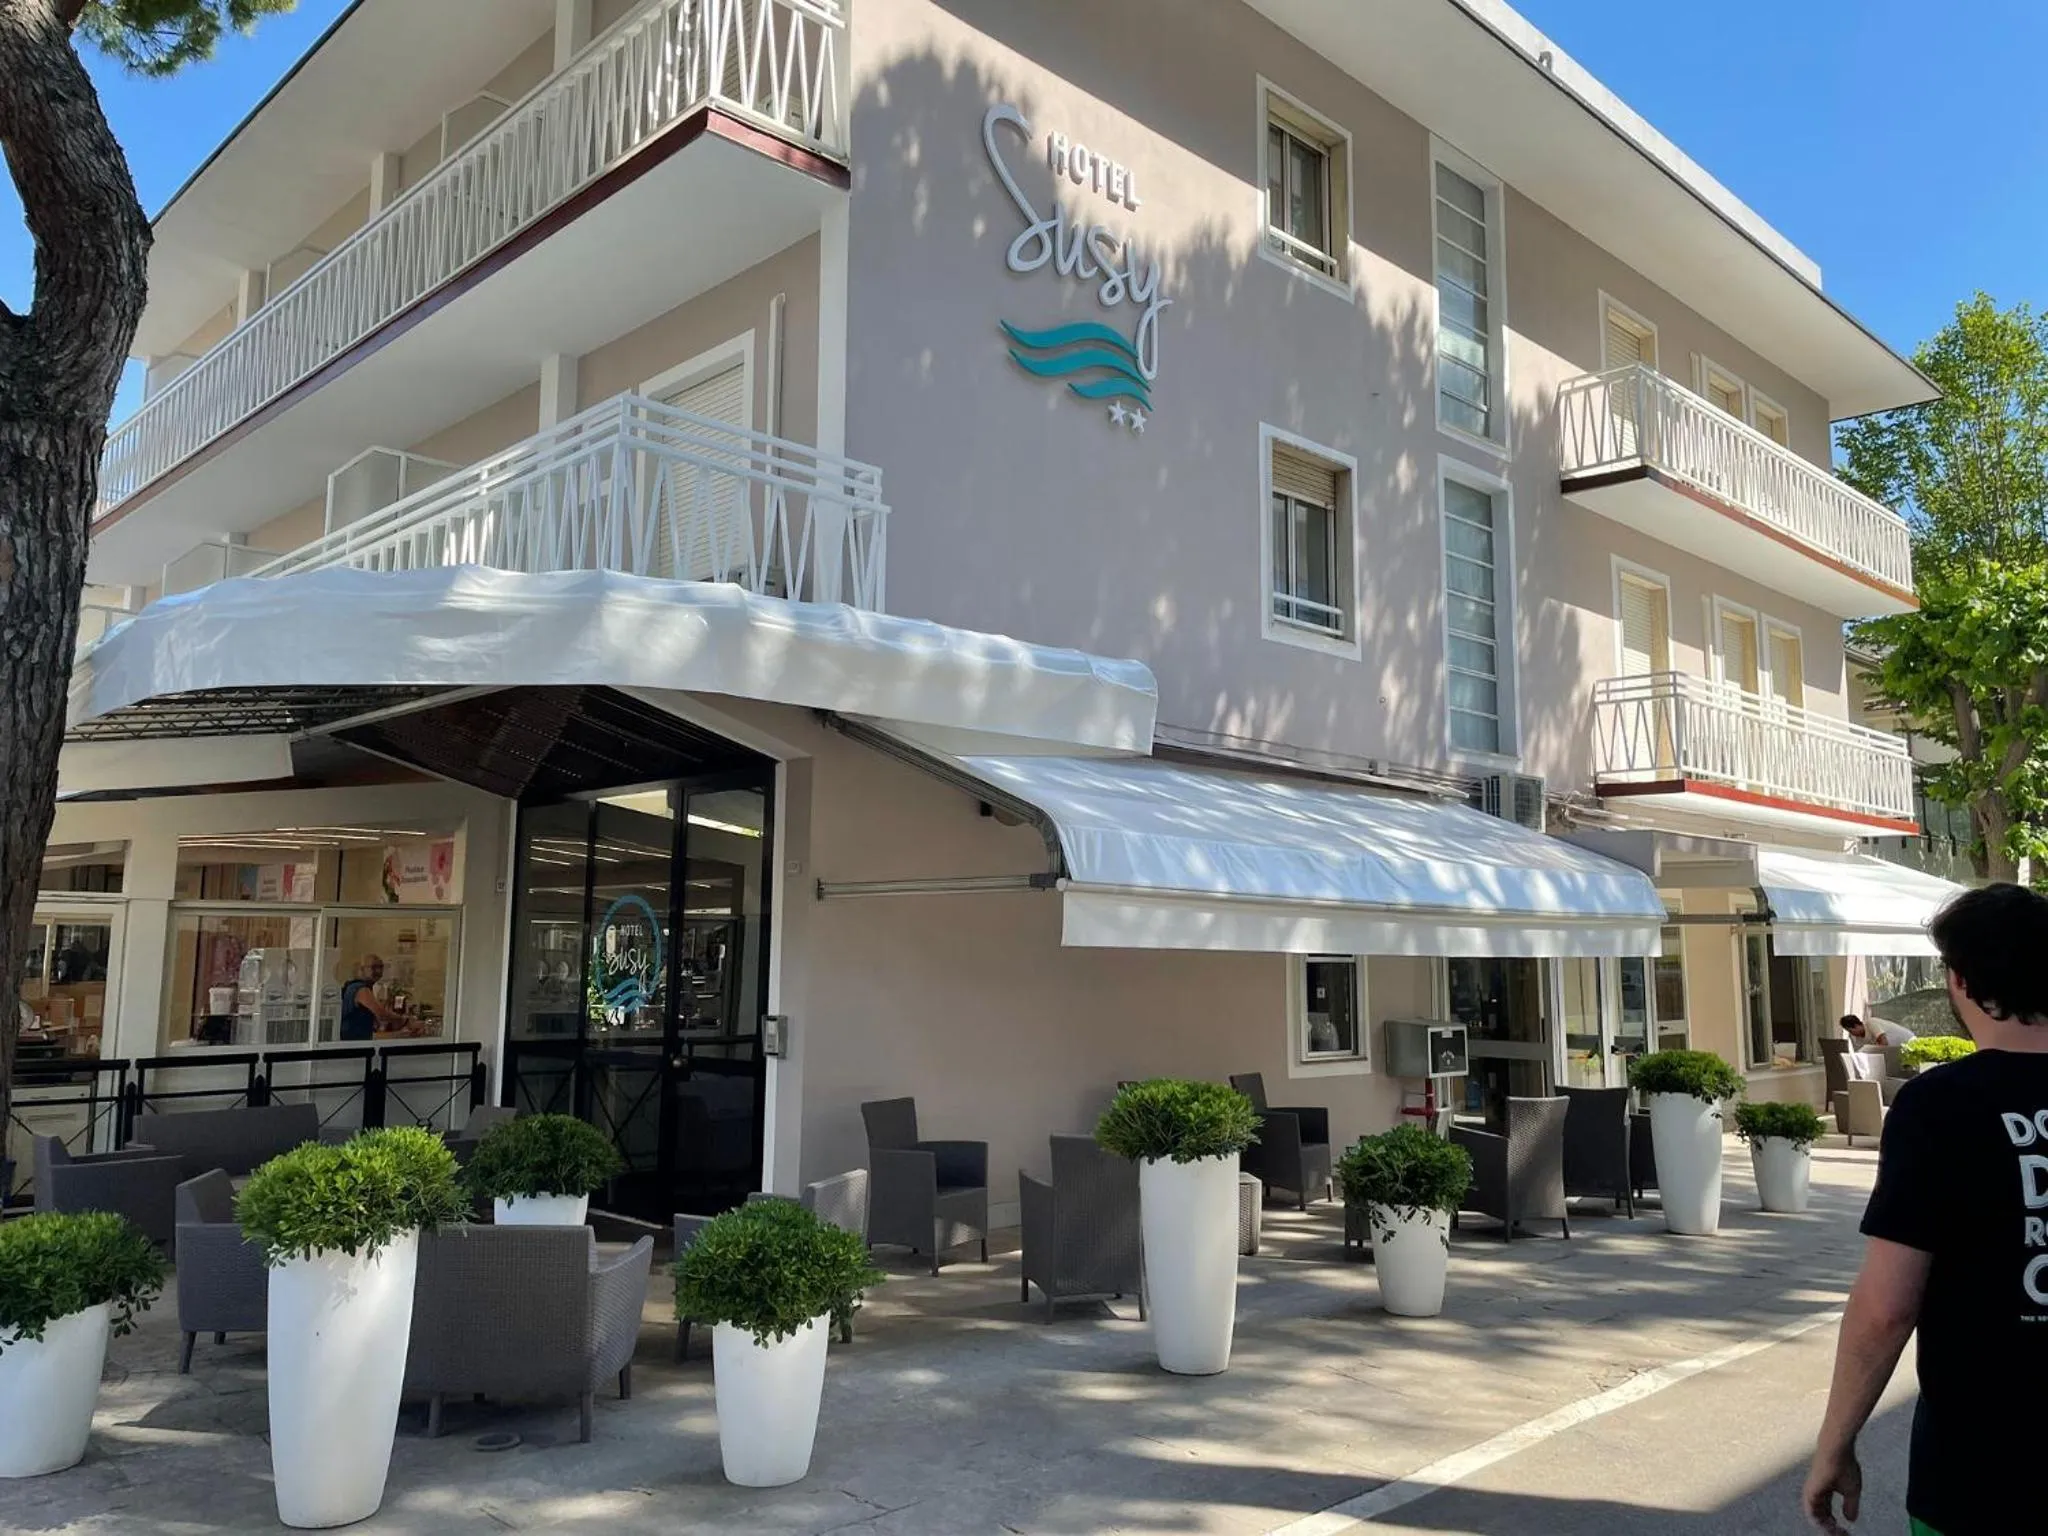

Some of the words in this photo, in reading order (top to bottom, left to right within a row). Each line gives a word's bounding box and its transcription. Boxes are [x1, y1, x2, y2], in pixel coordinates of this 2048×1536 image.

[1049, 131, 1142, 210] HOTEL
[984, 104, 1174, 380] Susy
[620, 924, 643, 937] HOTEL
[2024, 1216, 2048, 1246] R
